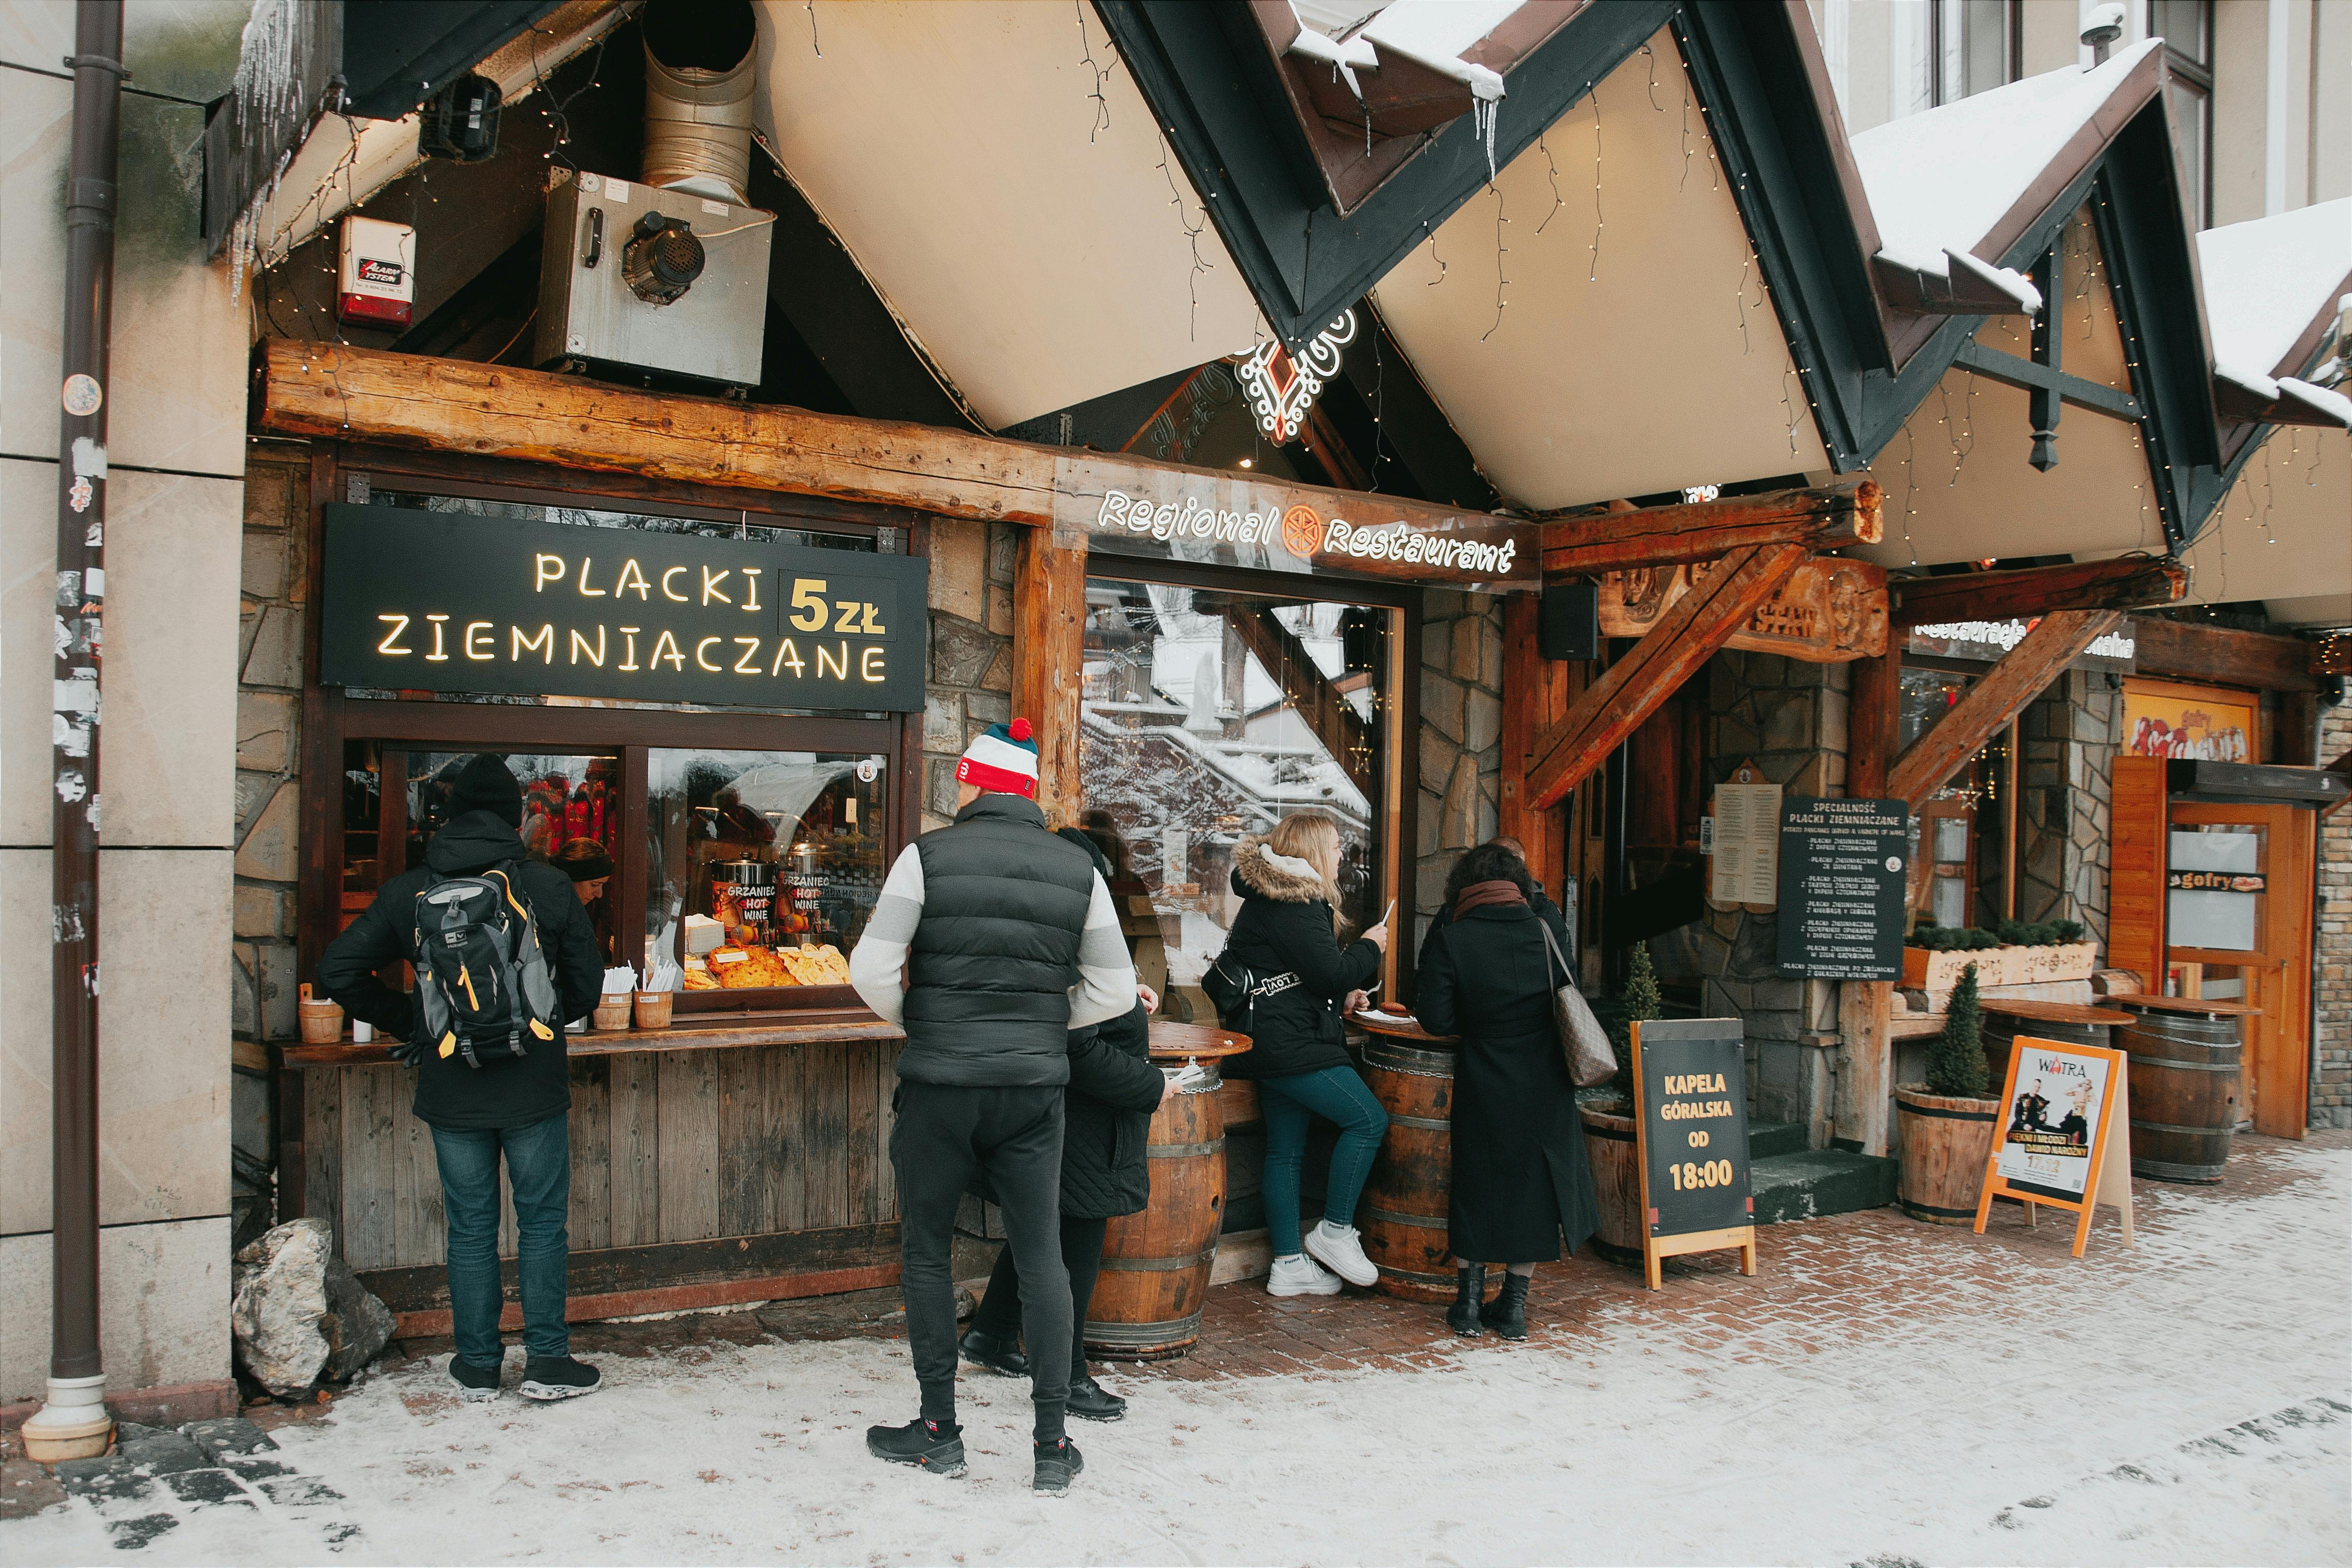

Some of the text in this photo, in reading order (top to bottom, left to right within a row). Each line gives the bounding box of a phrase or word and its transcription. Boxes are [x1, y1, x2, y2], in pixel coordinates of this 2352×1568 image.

[1099, 491, 1515, 574] Regional Restaurant
[536, 553, 762, 610] PLACKI
[378, 615, 886, 681] ZIEMNIACZANE
[1812, 801, 1876, 813] SPECIALNOŚĆ
[1790, 814, 1900, 825] PLACKI ZIEMNIACZANE
[783, 875, 829, 886] GRZANIEC
[2182, 872, 2233, 891] gofry
[728, 886, 775, 897] GRZANIEC
[797, 888, 817, 899] HOT
[746, 899, 766, 909] HOT
[795, 899, 820, 910] WINE
[744, 910, 768, 920] WINE
[2039, 1055, 2086, 1078] WATRA
[1664, 1073, 1727, 1095] KAPELA
[1660, 1100, 1733, 1120] GÓRALSKA
[1688, 1131, 1709, 1148] OD
[1669, 1159, 1733, 1191] 18:00
